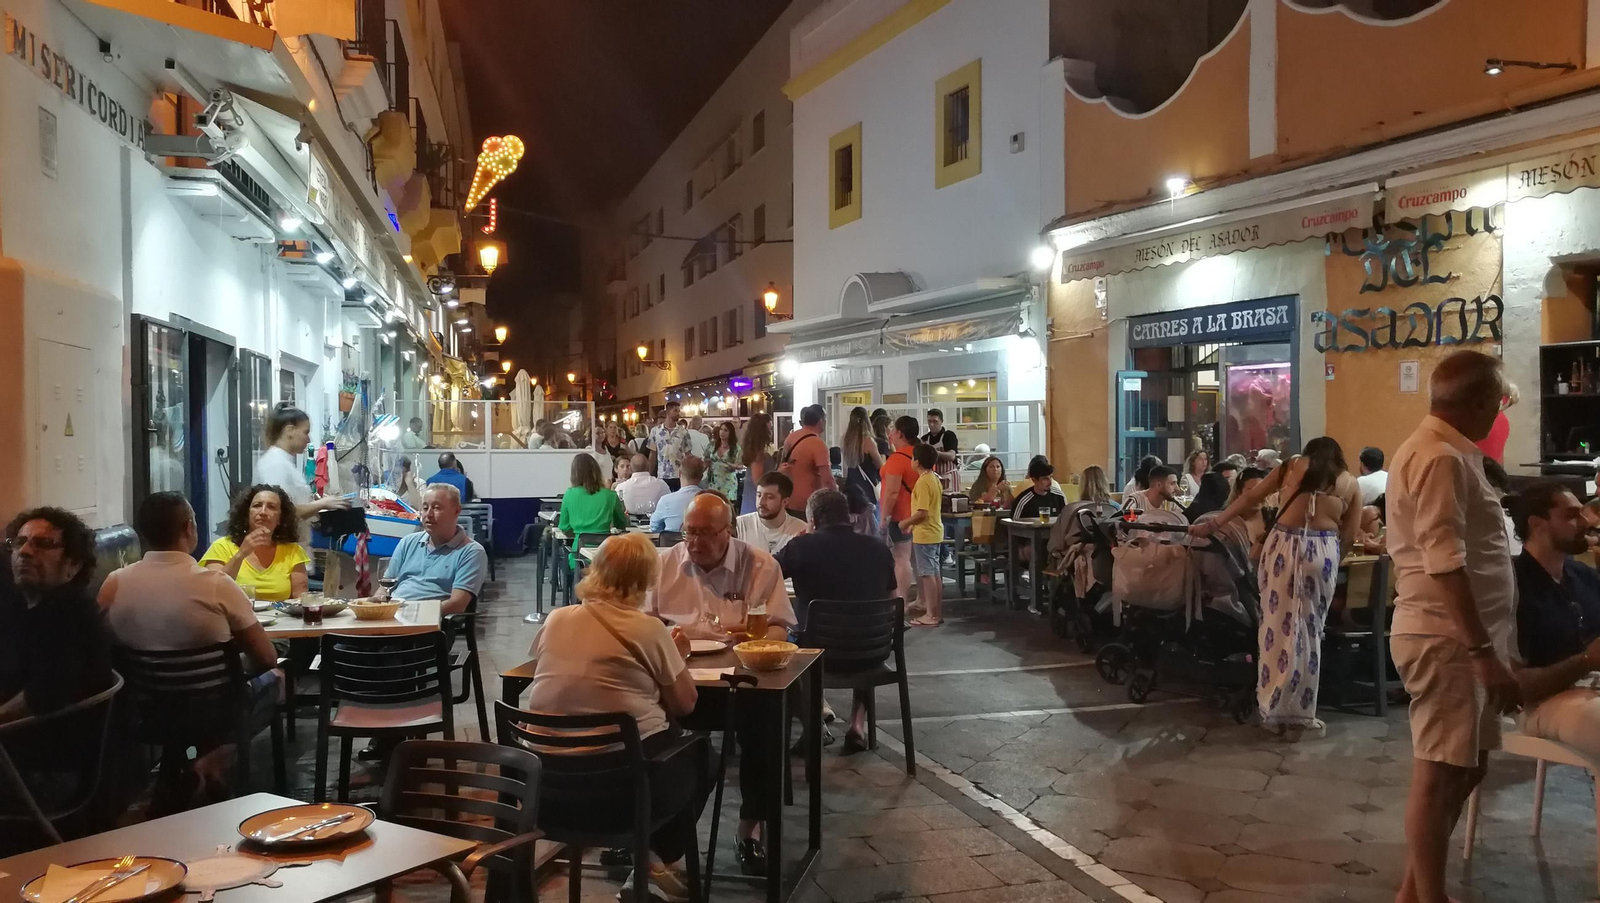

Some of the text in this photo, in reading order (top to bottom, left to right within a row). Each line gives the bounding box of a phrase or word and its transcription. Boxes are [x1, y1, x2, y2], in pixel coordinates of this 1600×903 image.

[13, 18, 147, 152] MISERICORDIA
[1518, 152, 1598, 189] MESÓN
[1398, 187, 1468, 210] Cruzcampo
[1301, 208, 1359, 229] Cruzcampo
[1135, 225, 1260, 263] MESÓN DEL ASADOR
[1067, 259, 1105, 274] Cruzcampo
[1132, 305, 1289, 341] CARNES A LA BRASA
